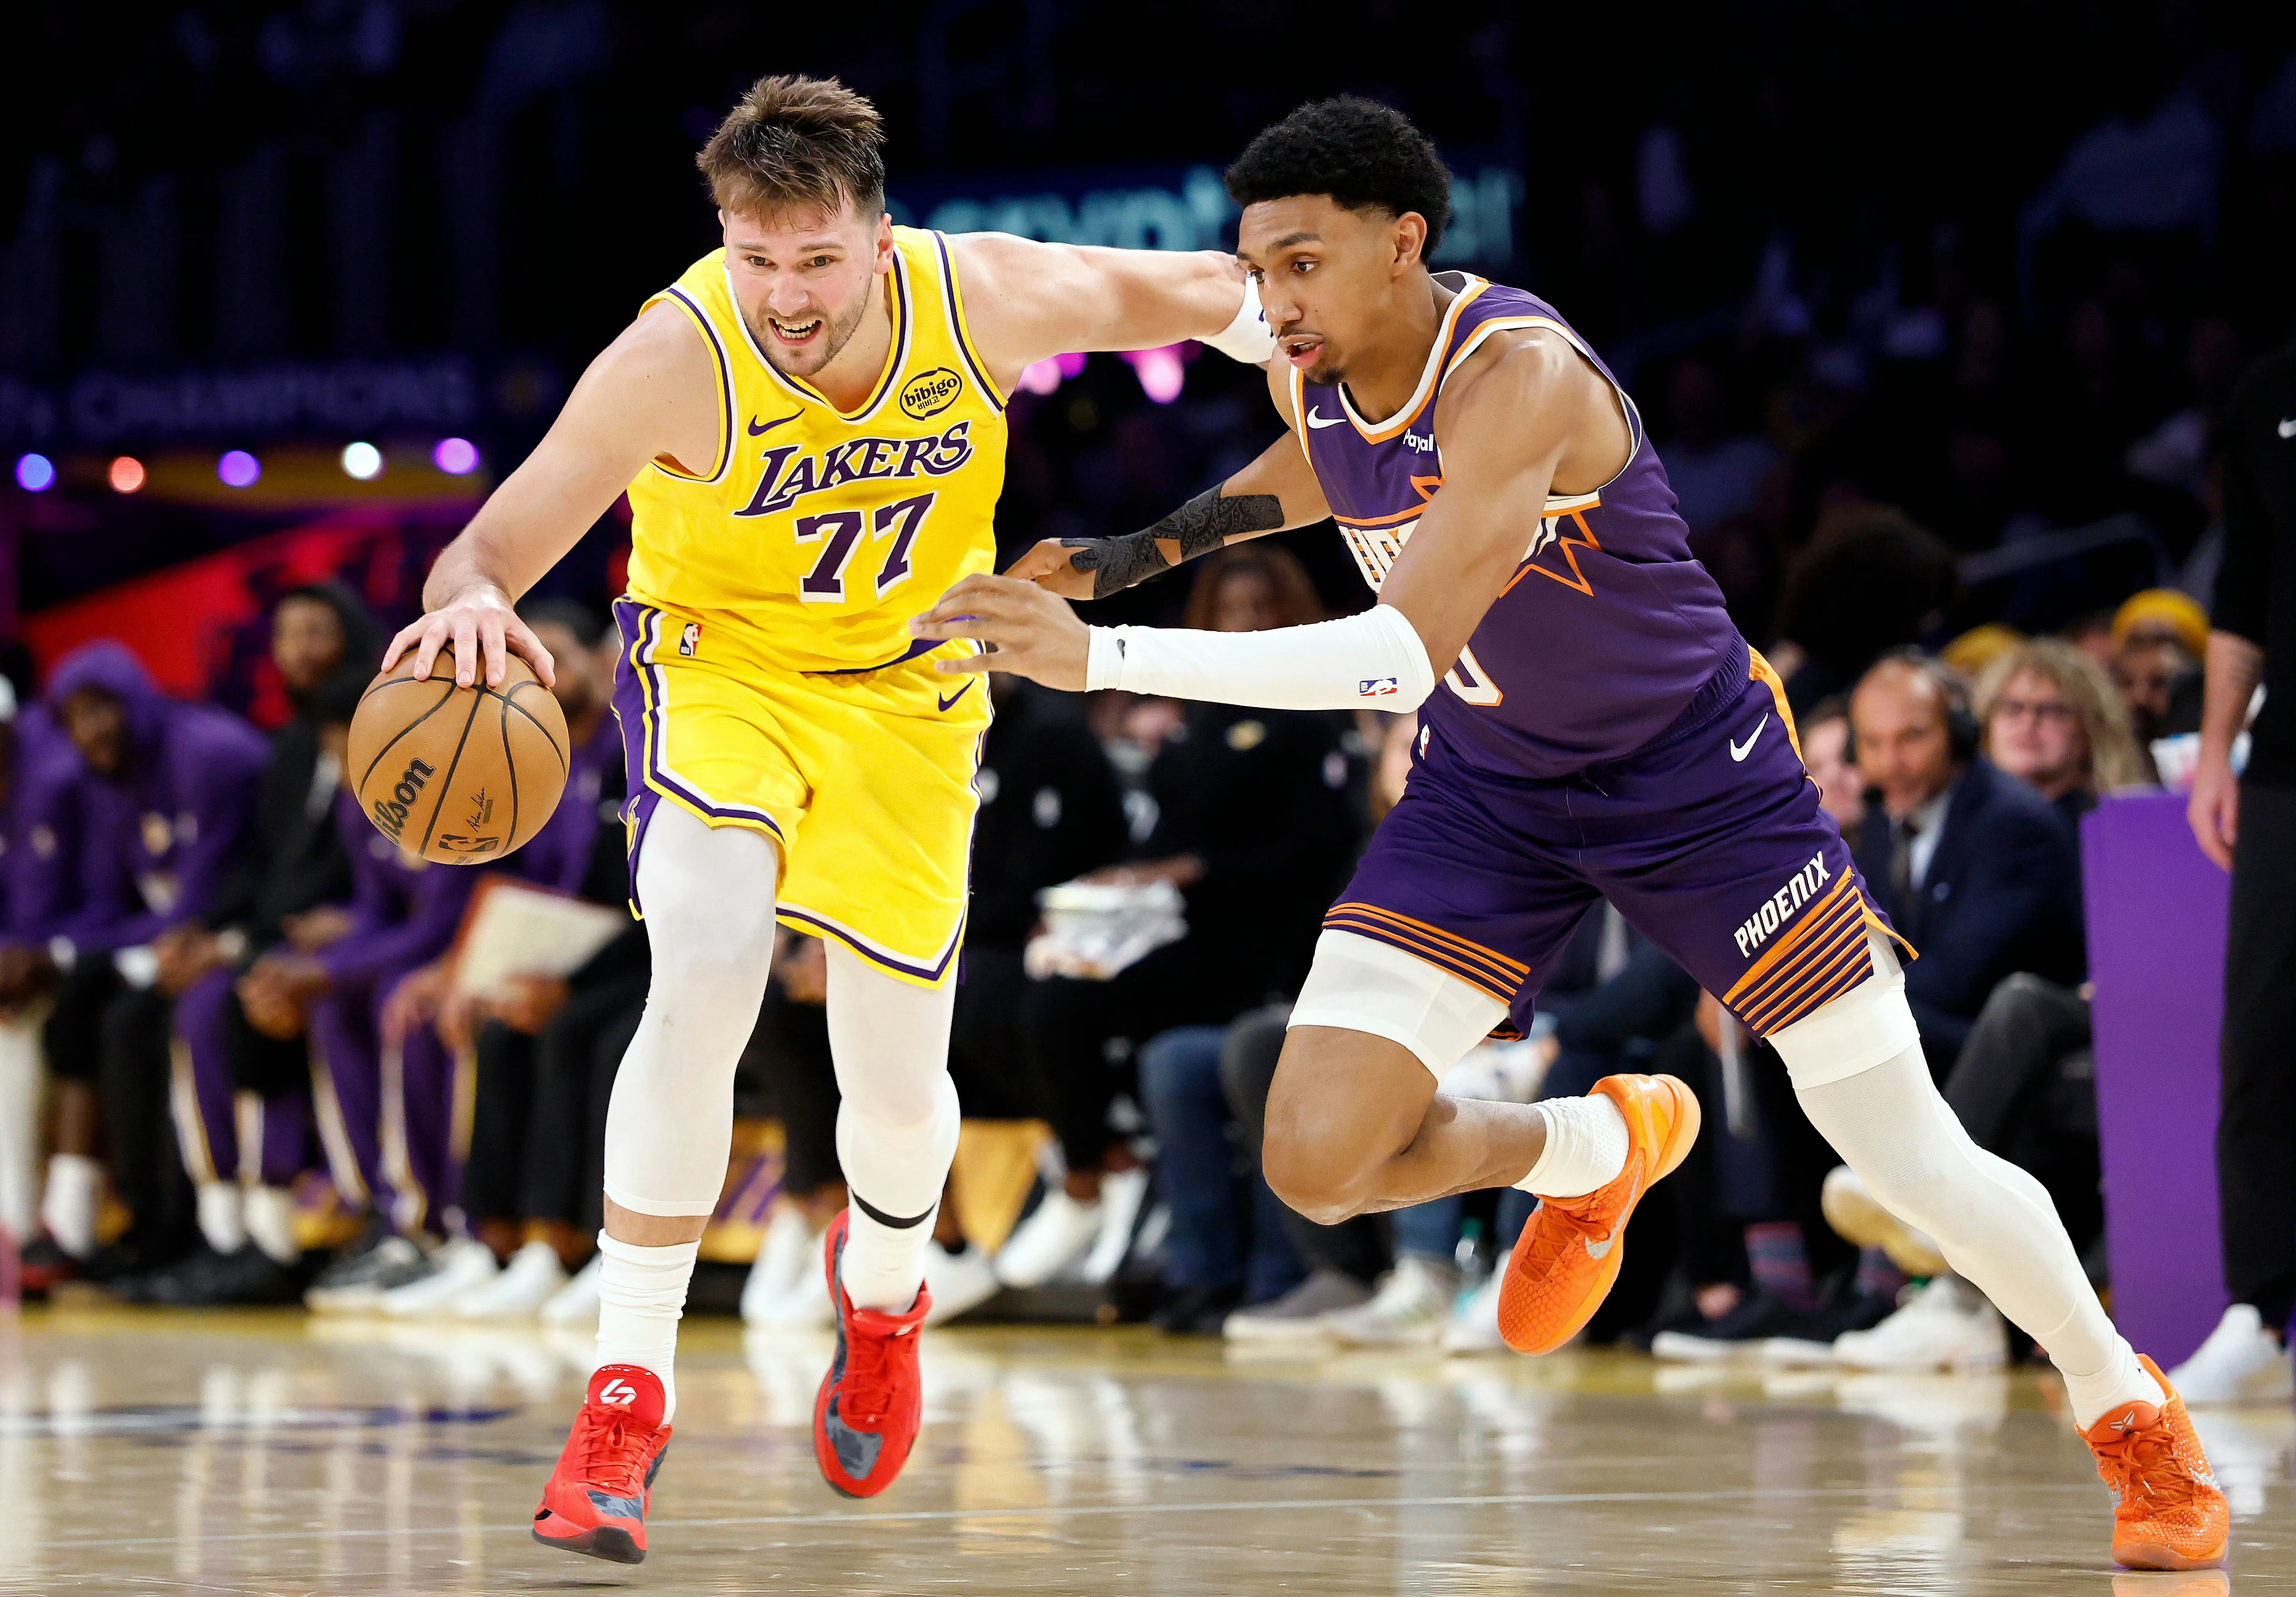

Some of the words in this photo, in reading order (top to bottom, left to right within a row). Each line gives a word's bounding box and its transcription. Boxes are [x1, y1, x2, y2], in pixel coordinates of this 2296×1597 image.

[904, 378, 958, 407] bibigo
[917, 395, 940, 410] 비비고
[730, 419, 975, 518] LAKERS
[1402, 428, 1434, 454] Payal
[792, 491, 939, 604] 77
[1734, 851, 1831, 958] PHOENIX
